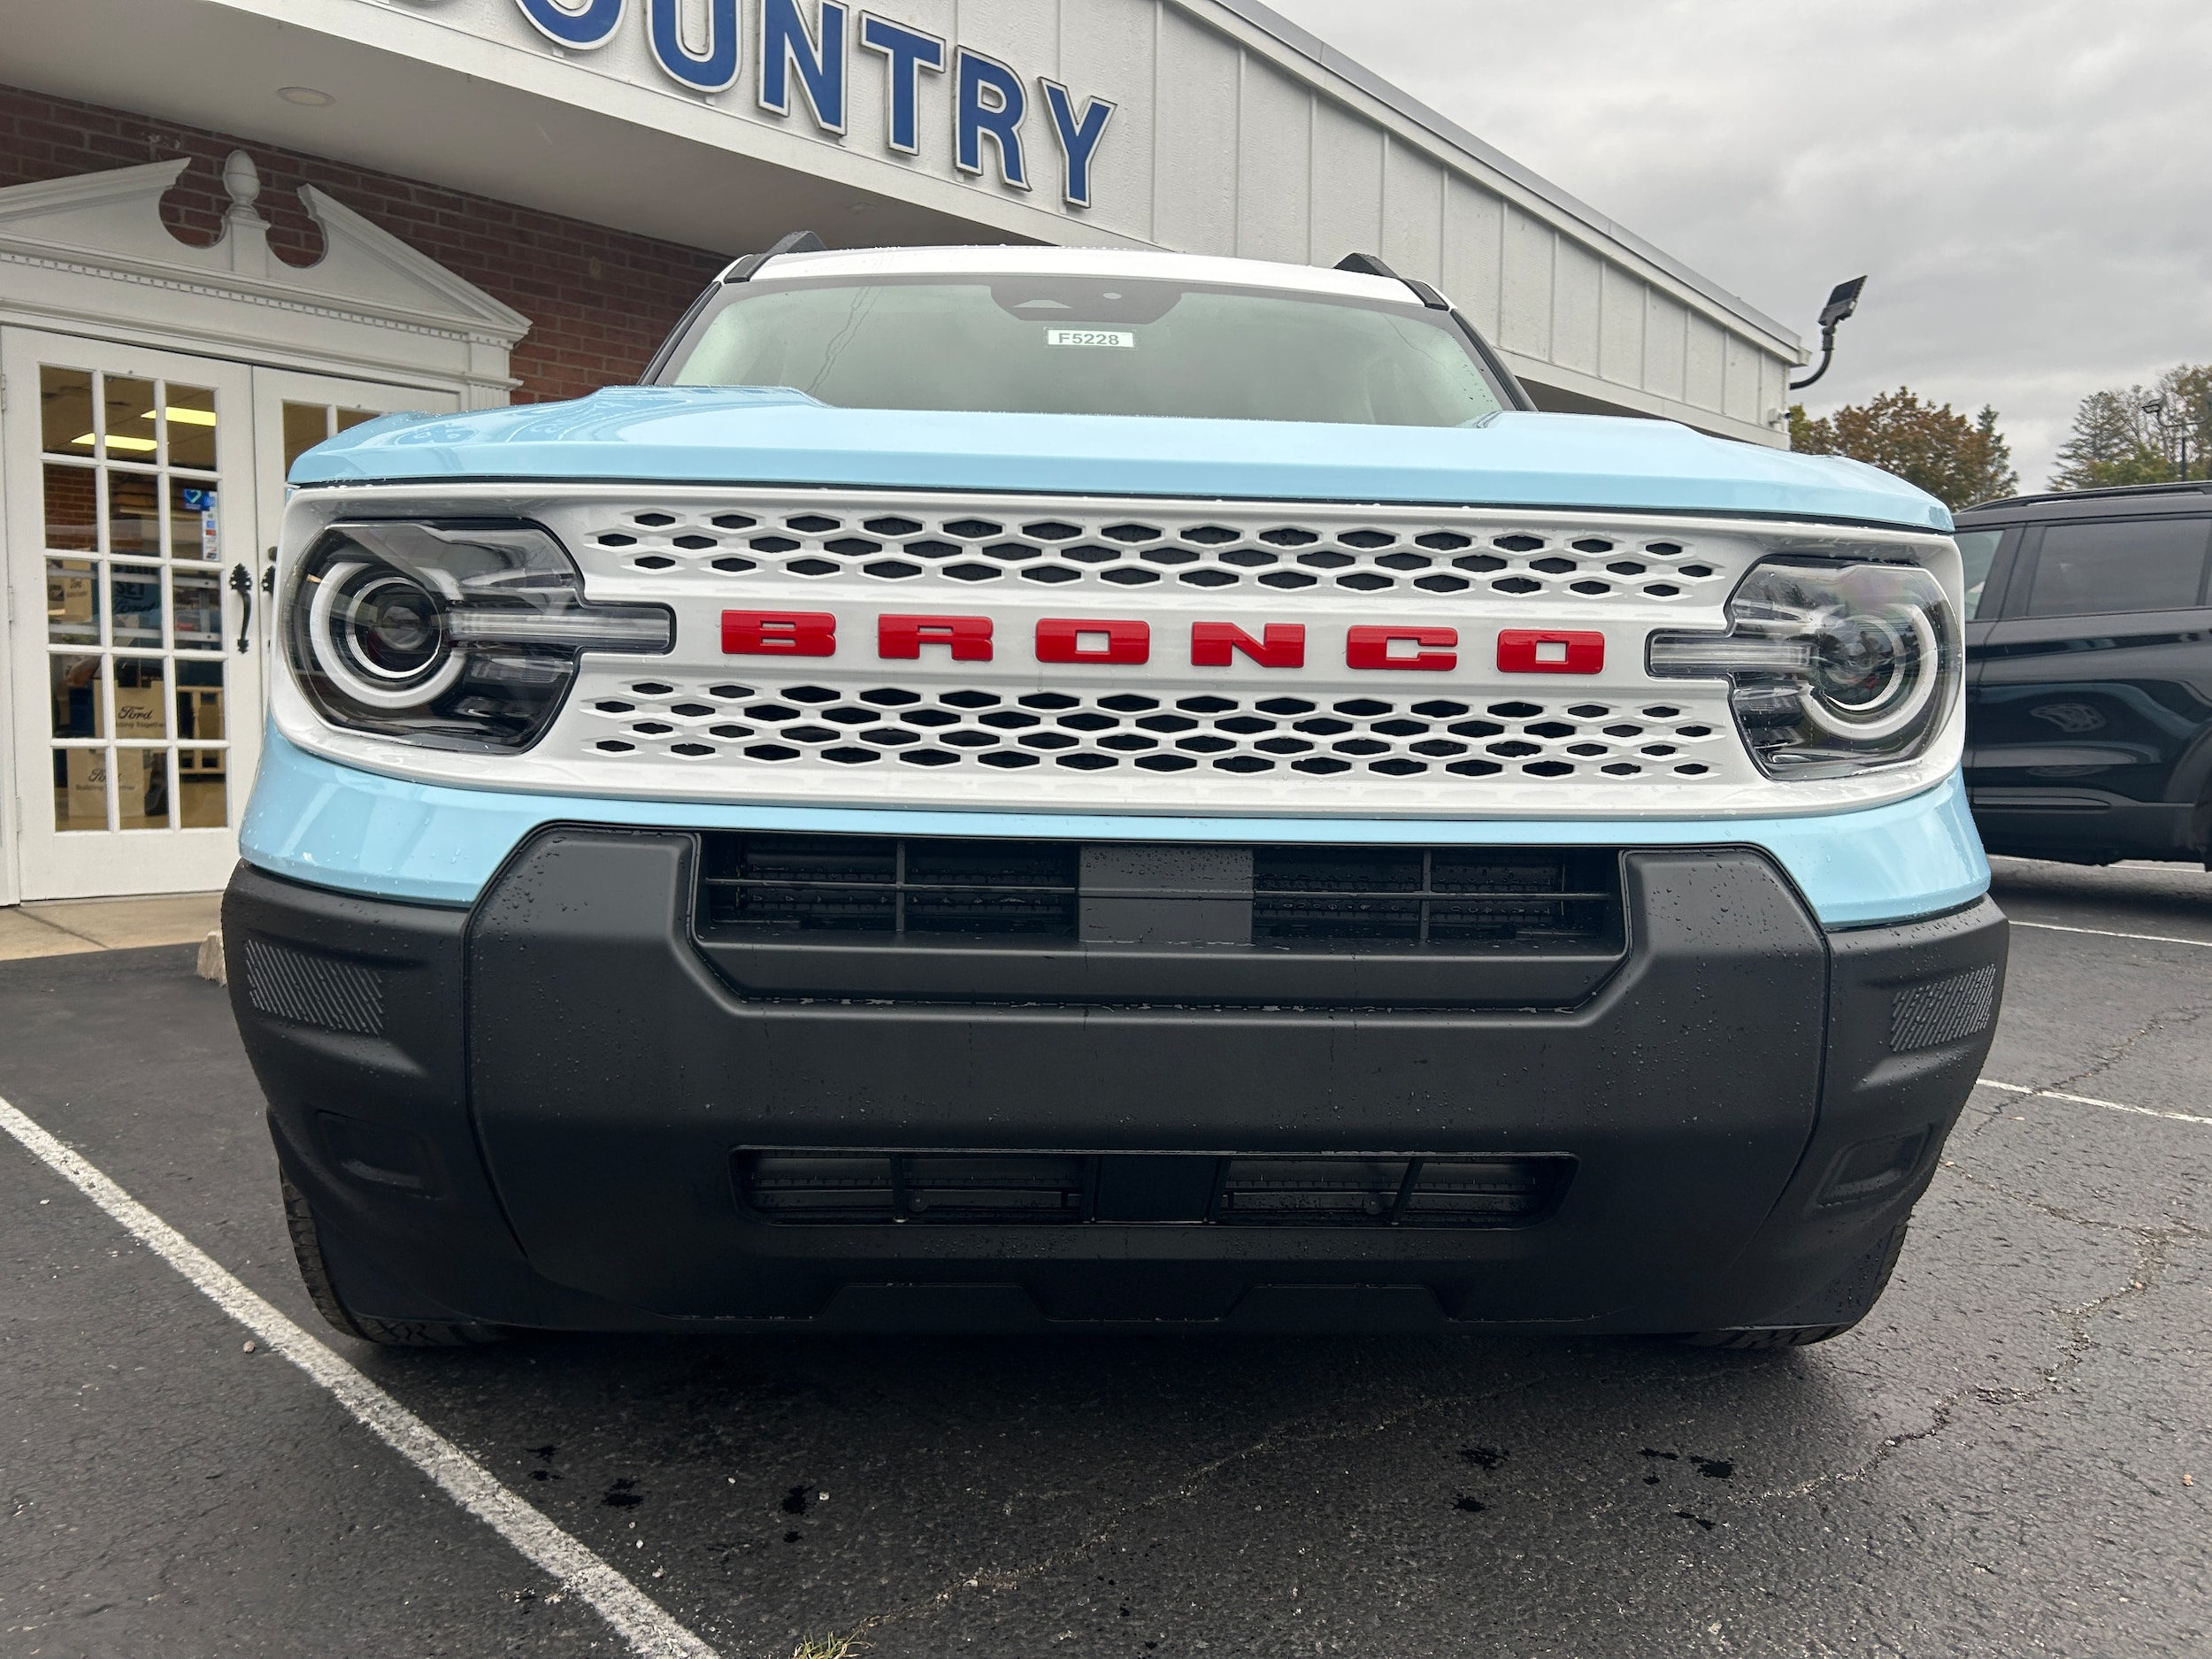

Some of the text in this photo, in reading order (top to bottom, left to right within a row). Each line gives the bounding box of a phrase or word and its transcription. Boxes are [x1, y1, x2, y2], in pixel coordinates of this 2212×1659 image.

[1058, 333, 1119, 345] F5228
[721, 609, 1605, 674] BRONCO
[118, 705, 154, 720] Ford
